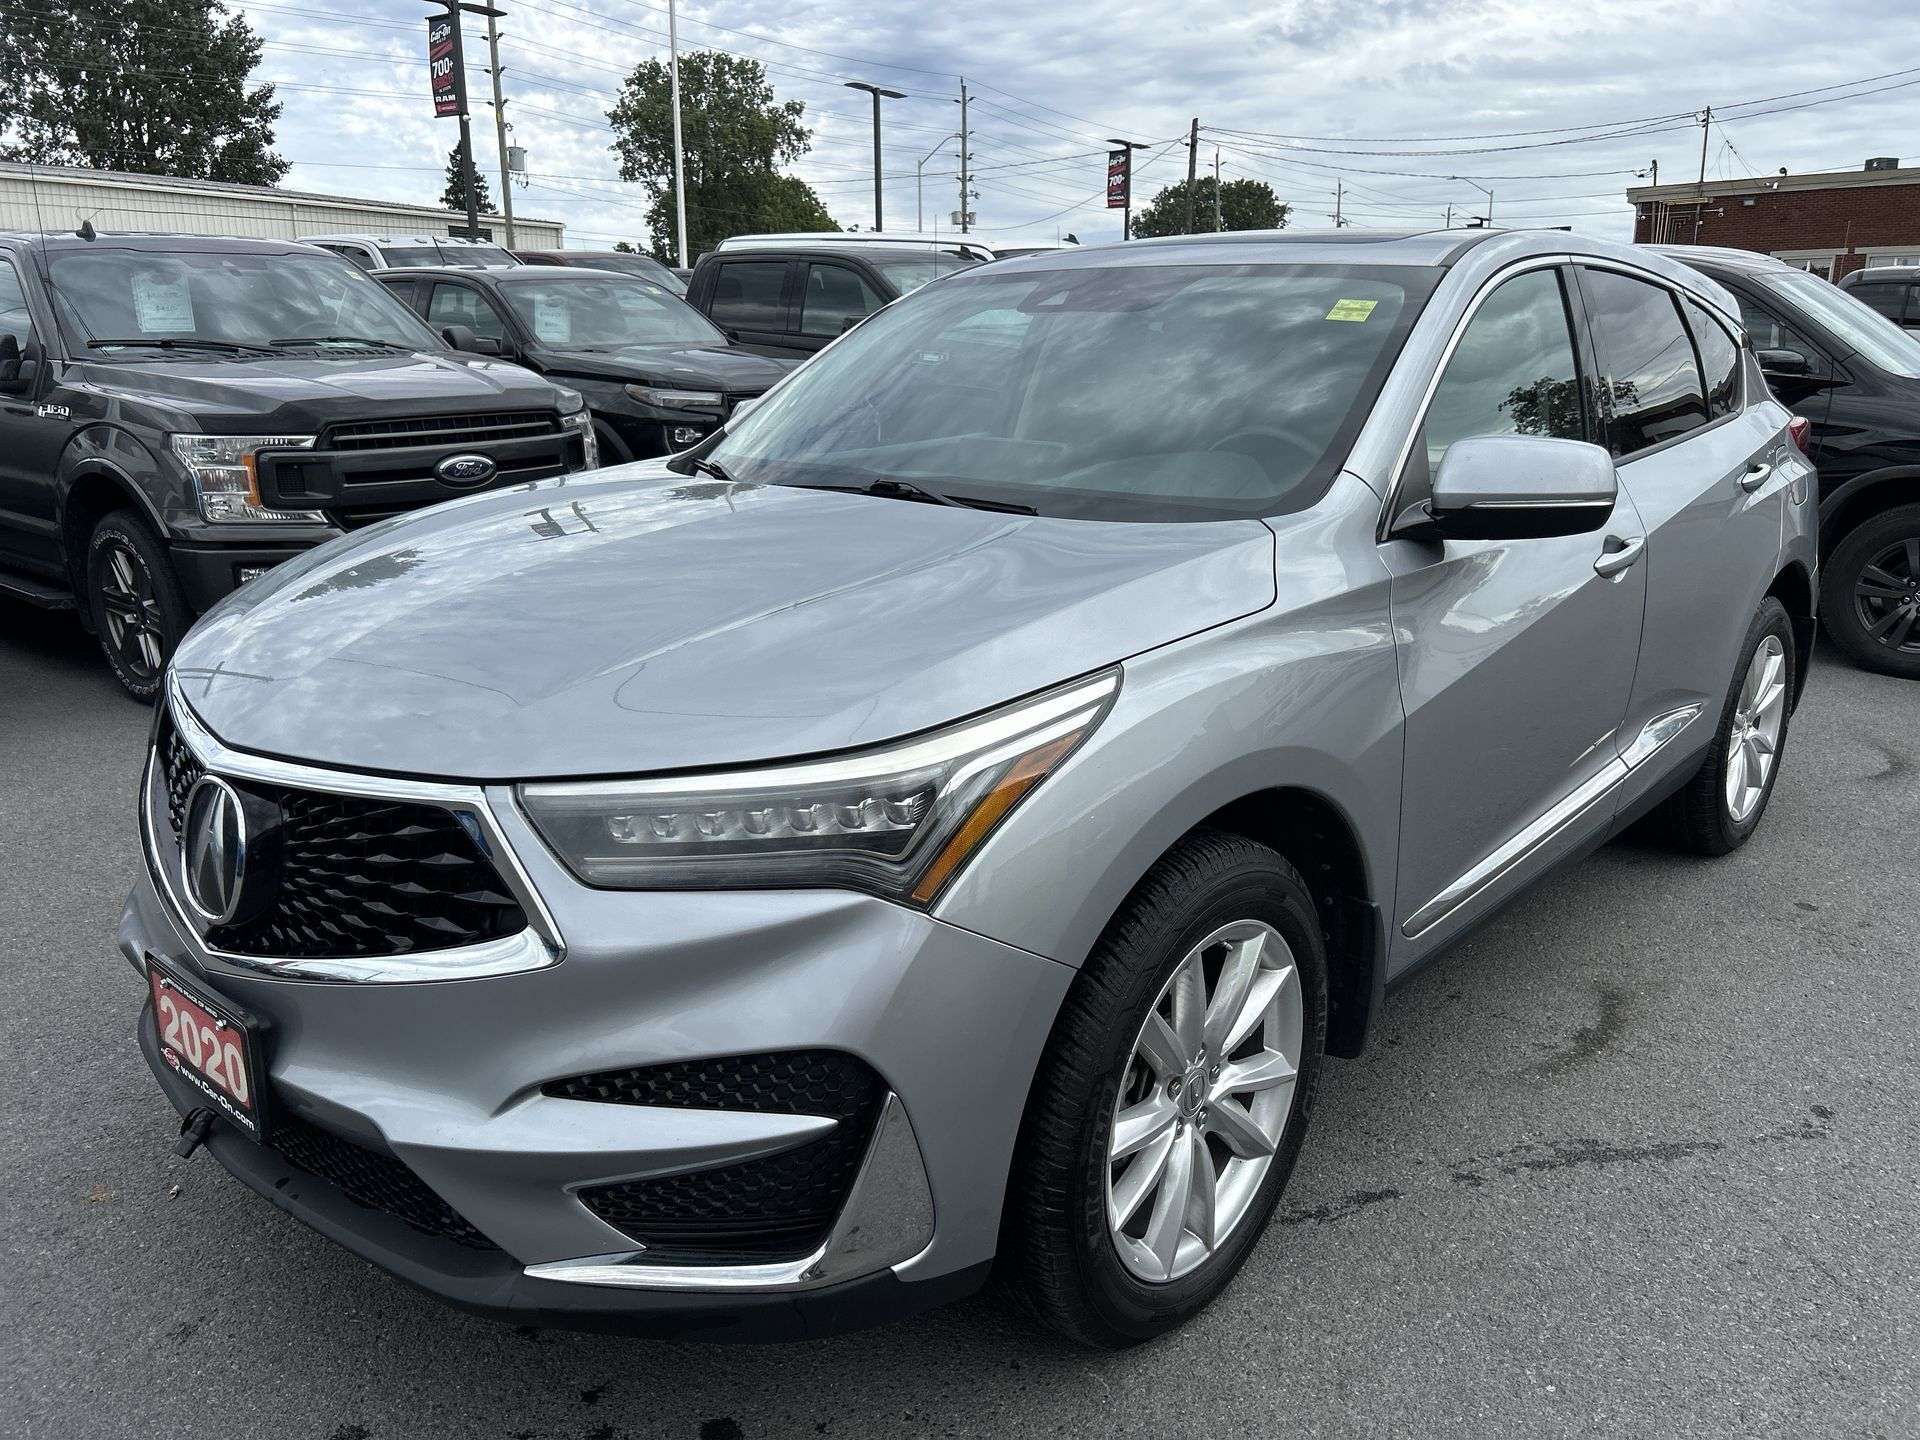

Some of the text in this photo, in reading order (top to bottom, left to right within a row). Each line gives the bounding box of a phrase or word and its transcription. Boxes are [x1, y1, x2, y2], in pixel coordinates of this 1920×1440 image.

[432, 57, 453, 79] 700+
[435, 94, 456, 103] RAM
[455, 462, 482, 476] Ford
[160, 995, 249, 1103] 2020
[180, 1066, 255, 1131] www.Car-On.com
